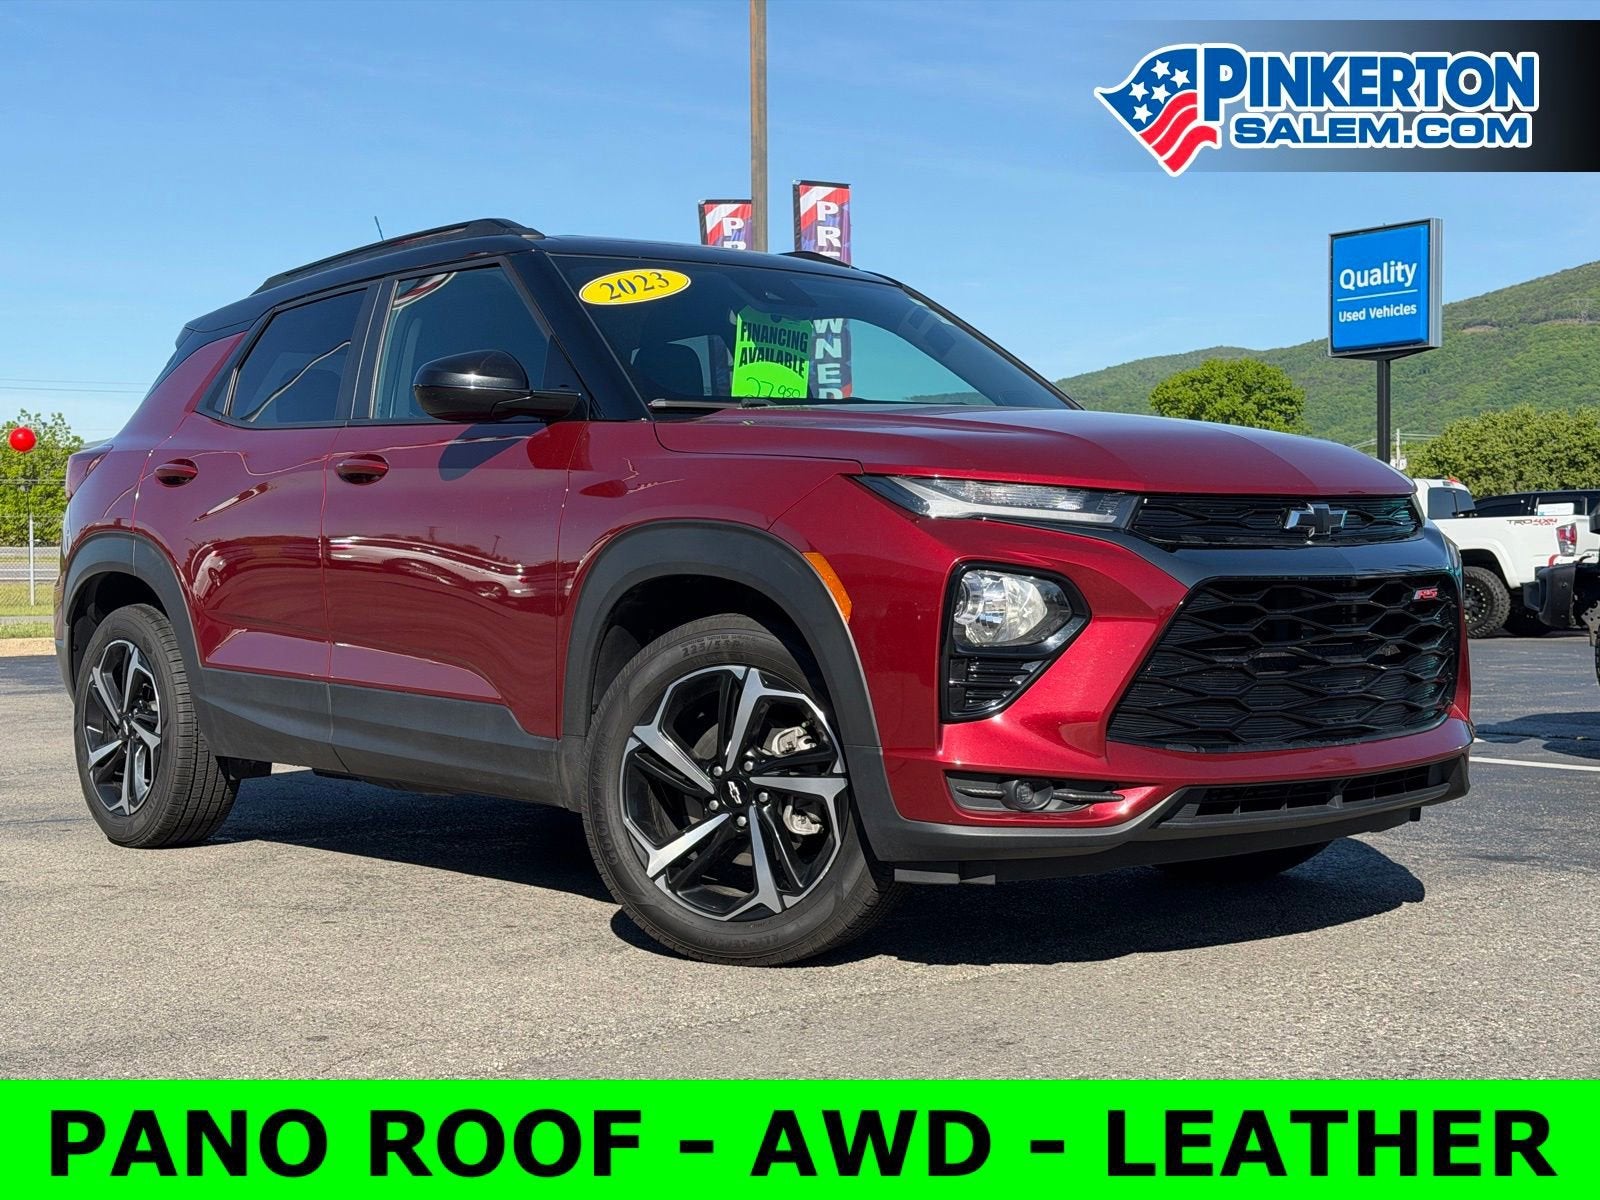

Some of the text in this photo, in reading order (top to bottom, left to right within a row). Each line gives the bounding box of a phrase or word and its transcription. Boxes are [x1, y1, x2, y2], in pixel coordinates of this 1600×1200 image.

[816, 200, 841, 257] PR
[600, 271, 669, 301] 2023
[1339, 260, 1417, 291] Quality
[1338, 303, 1417, 323] Used Vehicles
[741, 321, 809, 354] FINANCING
[739, 346, 806, 380] AVAILABLE
